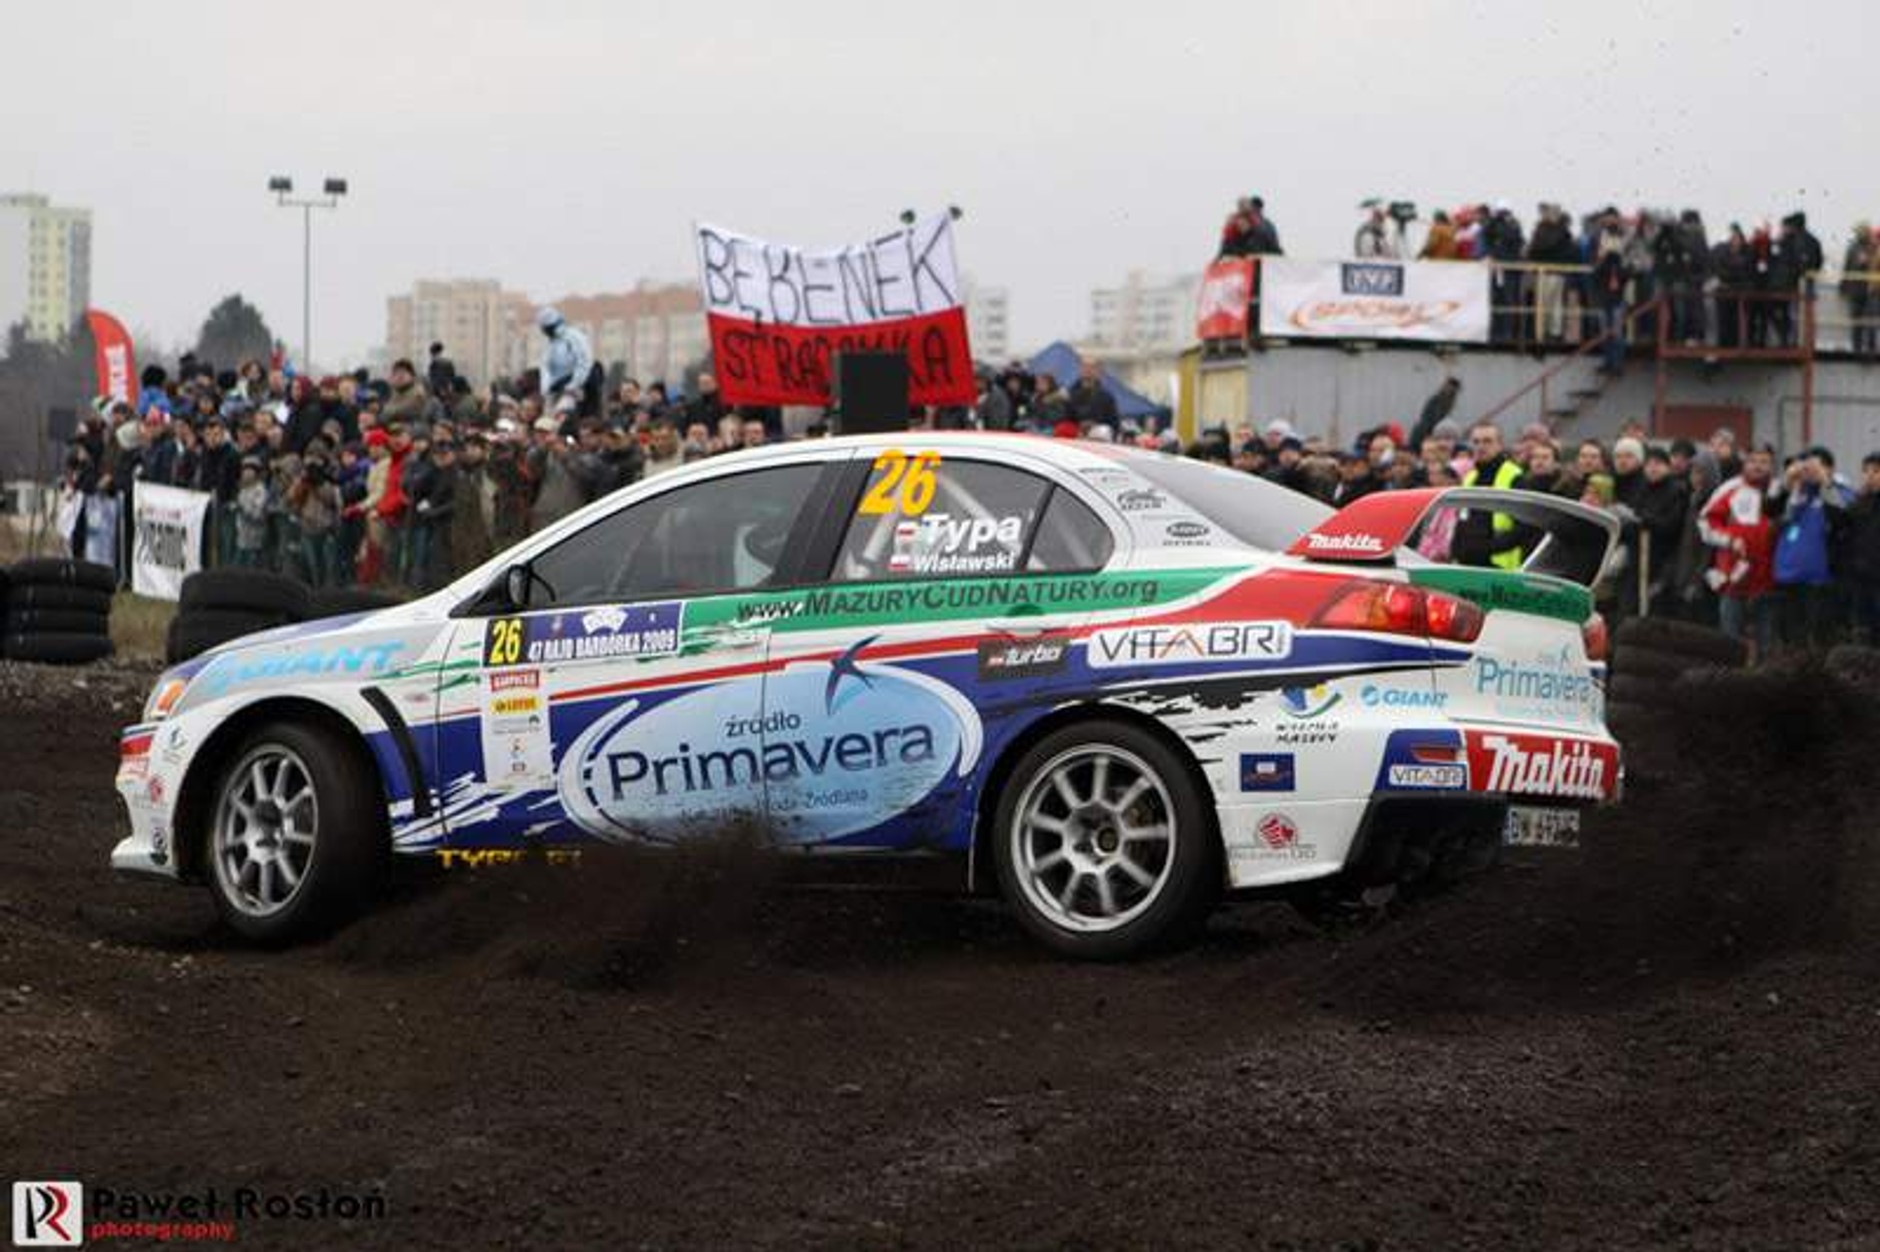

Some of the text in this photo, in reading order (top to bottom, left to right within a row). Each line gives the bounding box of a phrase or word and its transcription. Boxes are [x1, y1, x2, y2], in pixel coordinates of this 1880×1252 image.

[858, 449, 941, 517] 26
[922, 512, 1022, 553] Typa
[1308, 533, 1384, 551] Makita
[489, 619, 522, 664] 26
[642, 628, 675, 652] 2009
[1384, 690, 1447, 707] GIANT
[606, 722, 935, 802] Primavera
[1482, 735, 1606, 798] Makita
